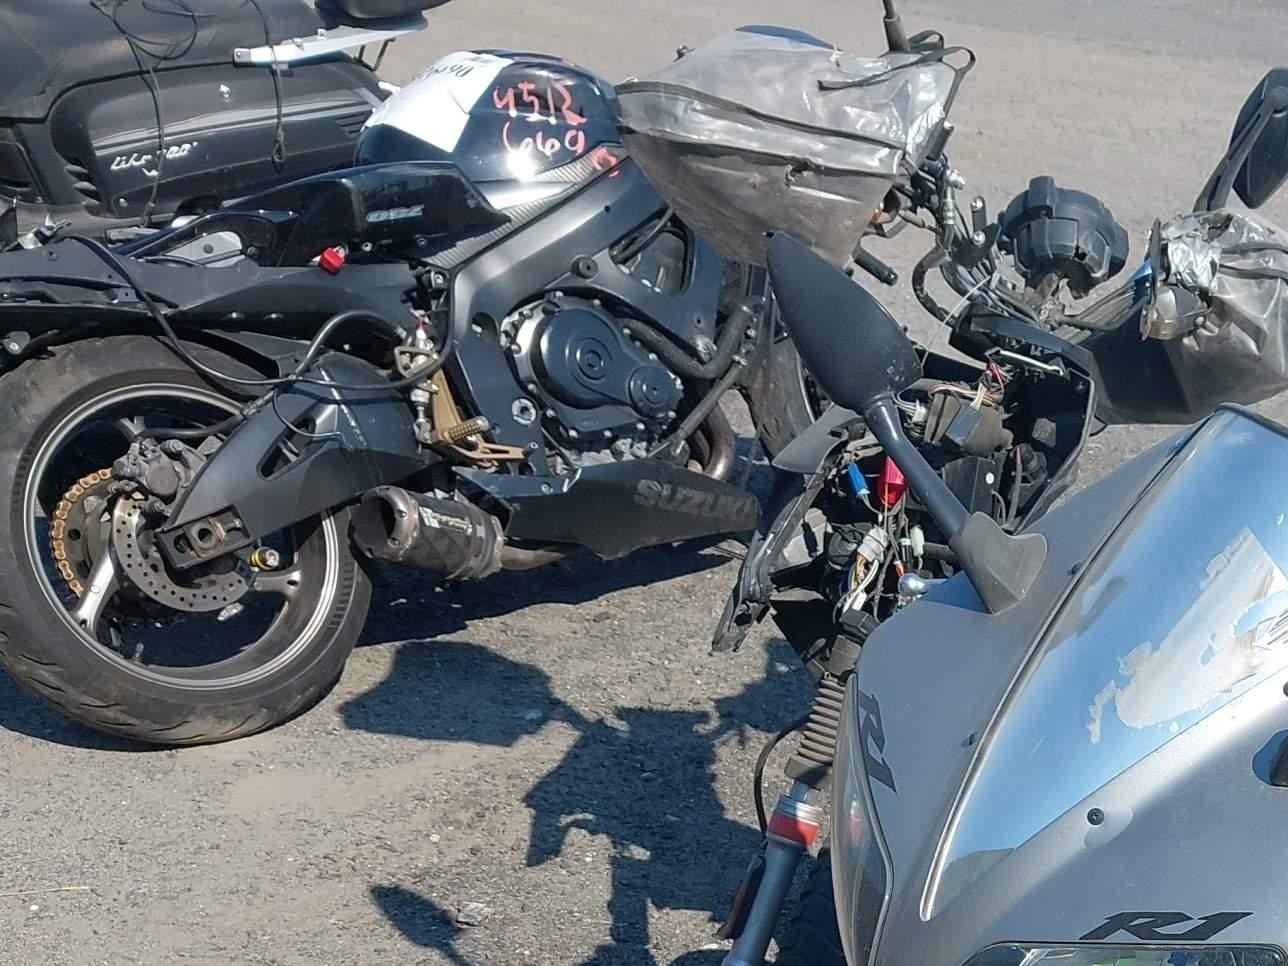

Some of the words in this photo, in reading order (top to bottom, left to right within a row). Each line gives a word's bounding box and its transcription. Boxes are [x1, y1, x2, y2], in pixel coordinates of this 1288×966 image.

[633, 479, 761, 521] SUZUKI
[858, 688, 898, 793] R1
[1079, 911, 1254, 941] R1
